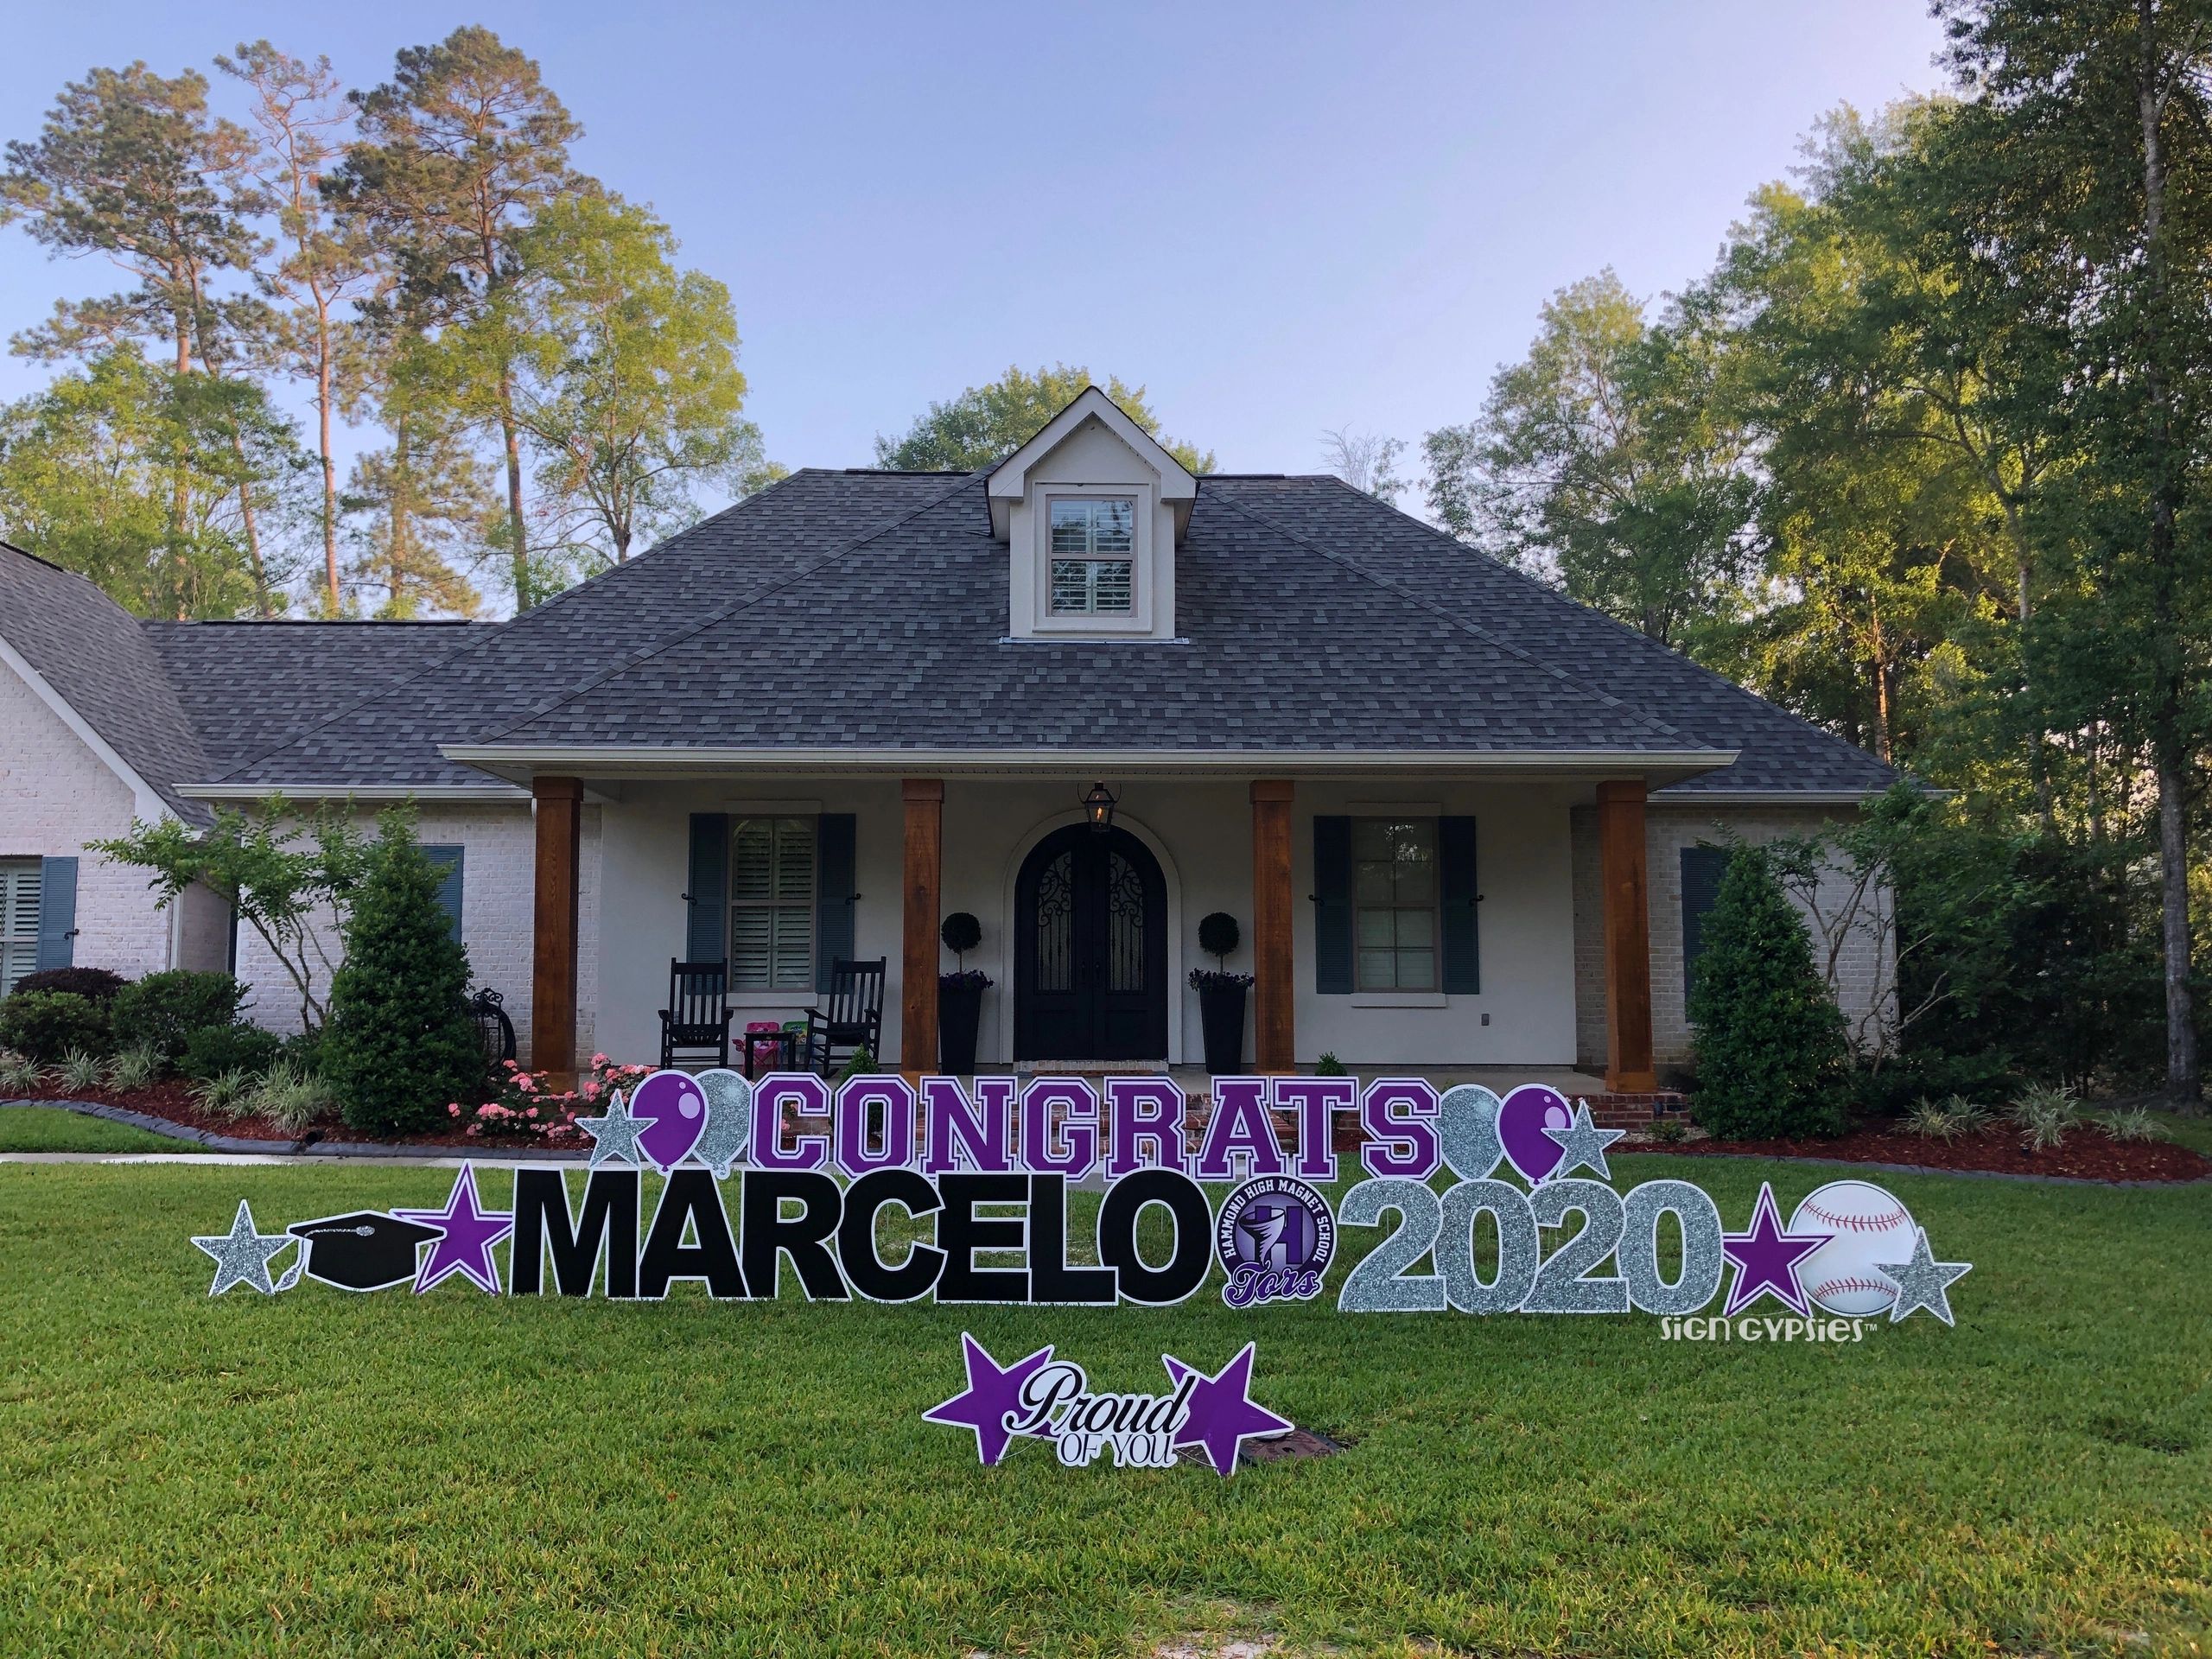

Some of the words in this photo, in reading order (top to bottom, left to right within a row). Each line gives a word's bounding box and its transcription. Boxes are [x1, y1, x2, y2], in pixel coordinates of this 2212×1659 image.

[748, 1072, 1442, 1180] CONGRATS
[509, 1166, 1211, 1306] MARCELO
[1338, 1178, 1723, 1315] 2020
[1221, 1195, 1246, 1258] HAMMOND
[1244, 1179, 1274, 1199] HIGH
[1278, 1179, 1324, 1213] MAGNET
[1313, 1216, 1331, 1263] SCHOOL
[1225, 1260, 1319, 1306] Tors
[1006, 1365, 1187, 1433] Proud
[1060, 1433, 1103, 1462] OF
[1111, 1433, 1176, 1464] YOU
